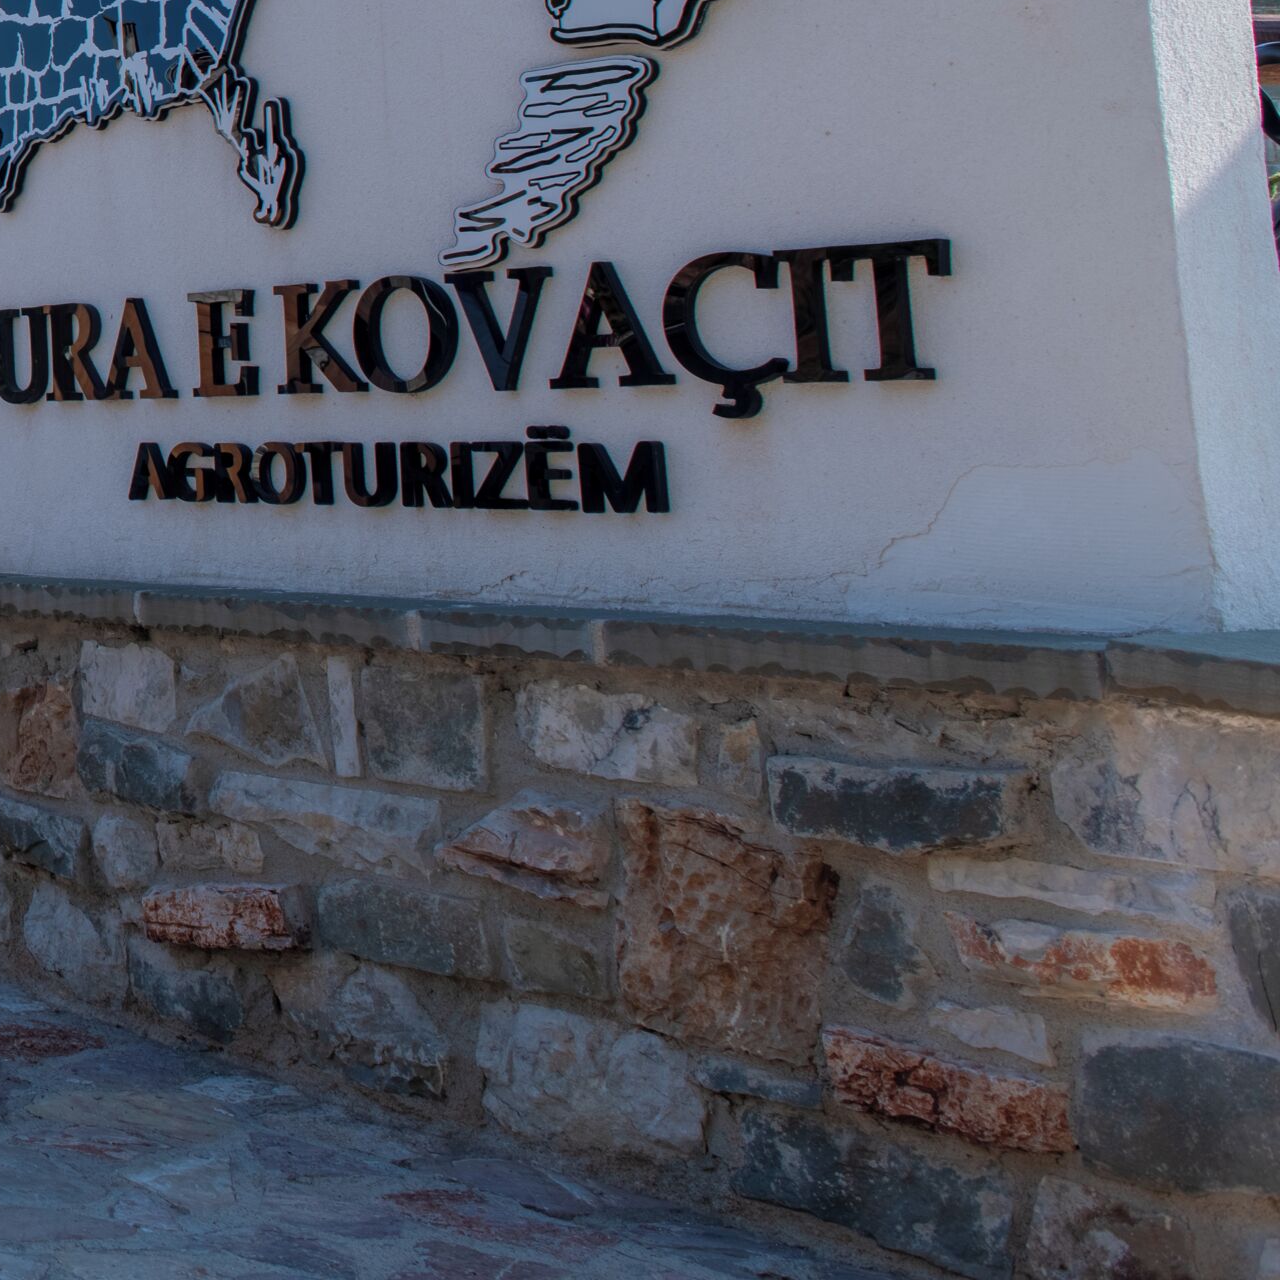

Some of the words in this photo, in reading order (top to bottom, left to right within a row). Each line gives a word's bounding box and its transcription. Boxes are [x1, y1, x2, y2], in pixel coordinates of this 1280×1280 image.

[187, 288, 261, 398] E
[273, 237, 953, 420] KOVAÇIT
[127, 424, 671, 515] AGROTURIZËM
